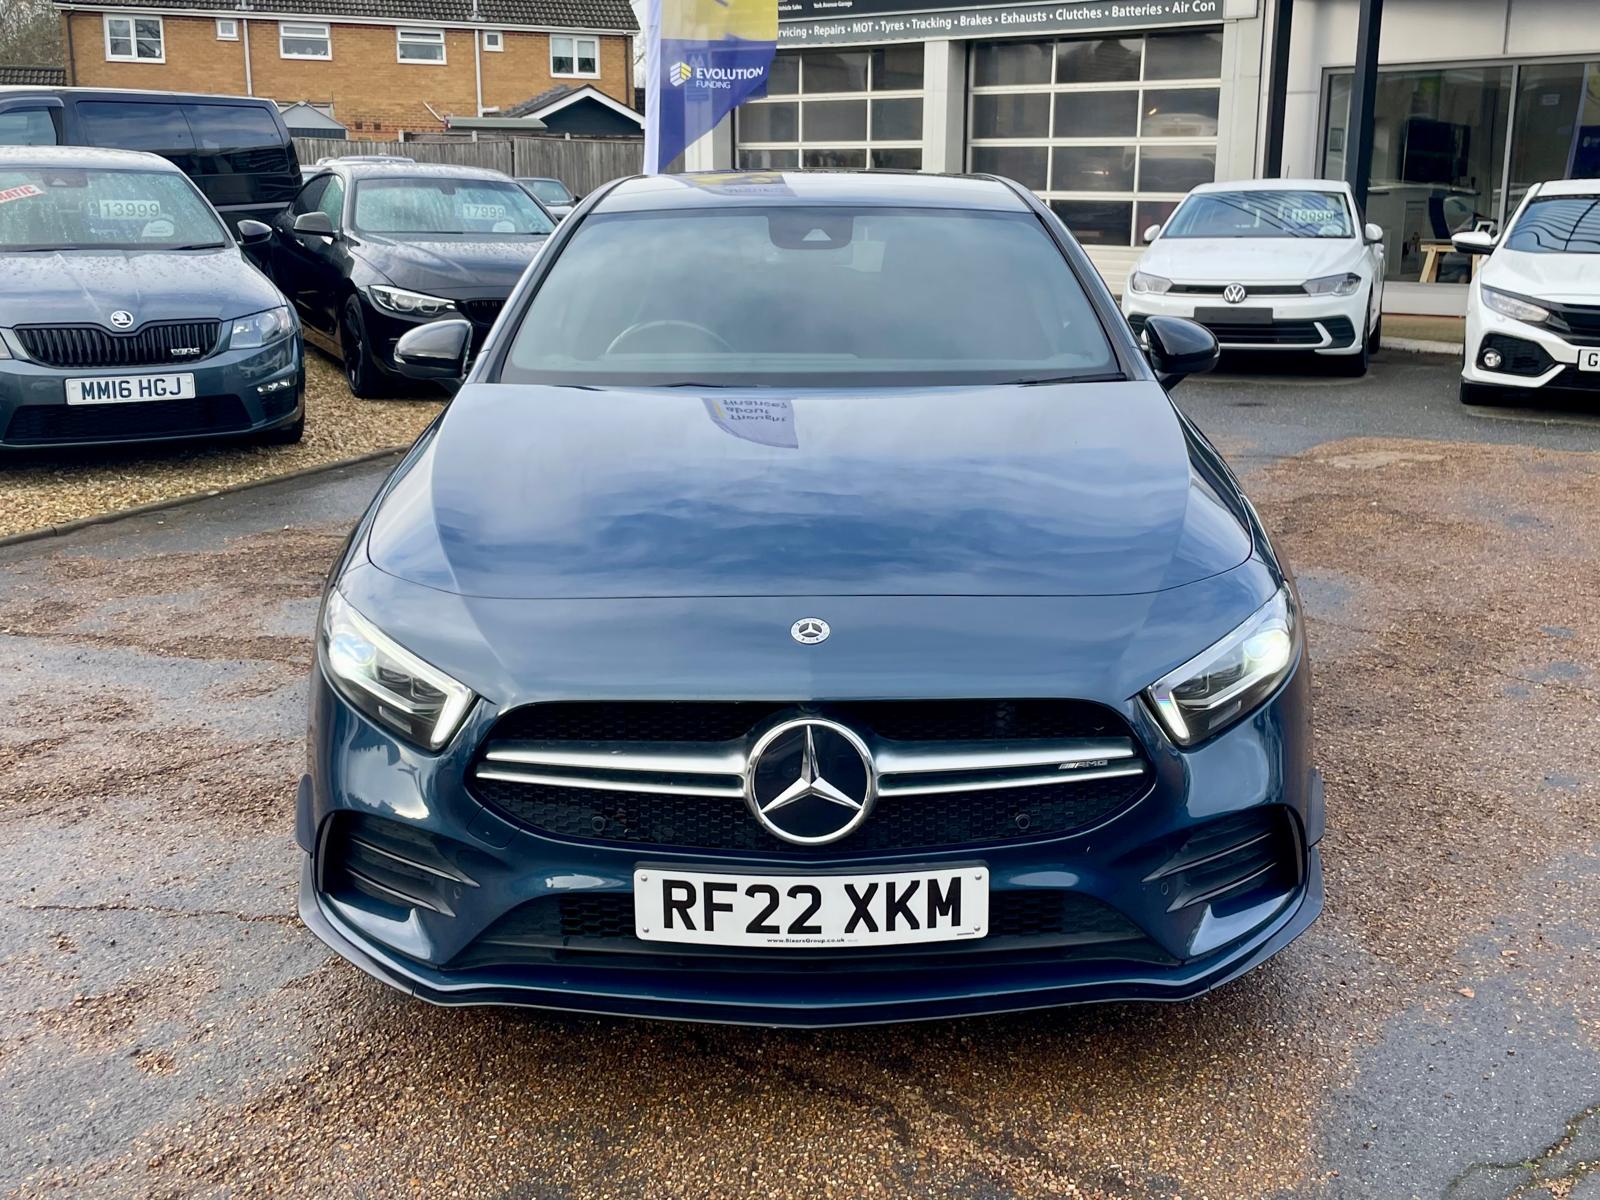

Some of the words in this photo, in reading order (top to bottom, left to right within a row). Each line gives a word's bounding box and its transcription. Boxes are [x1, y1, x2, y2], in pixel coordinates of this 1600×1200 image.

[778, 27, 807, 39] rvicing
[814, 24, 846, 37] Repairs
[852, 22, 874, 34] MOT
[880, 21, 905, 33] Tyres
[912, 17, 952, 30] Tracking
[960, 14, 993, 27] Brakes
[1001, 11, 1047, 24] Exhausts
[1055, 7, 1102, 21] Clutches
[1112, 4, 1163, 18] Batteries
[1172, 1, 1190, 14] Air
[1193, 0, 1217, 13] Con
[696, 66, 764, 81] EVOLUTION
[696, 80, 731, 89] FUNDING
[81, 377, 132, 400] MM16
[138, 375, 182, 399] HGJ
[662, 878, 823, 935] RF22
[843, 876, 962, 934] XKM
